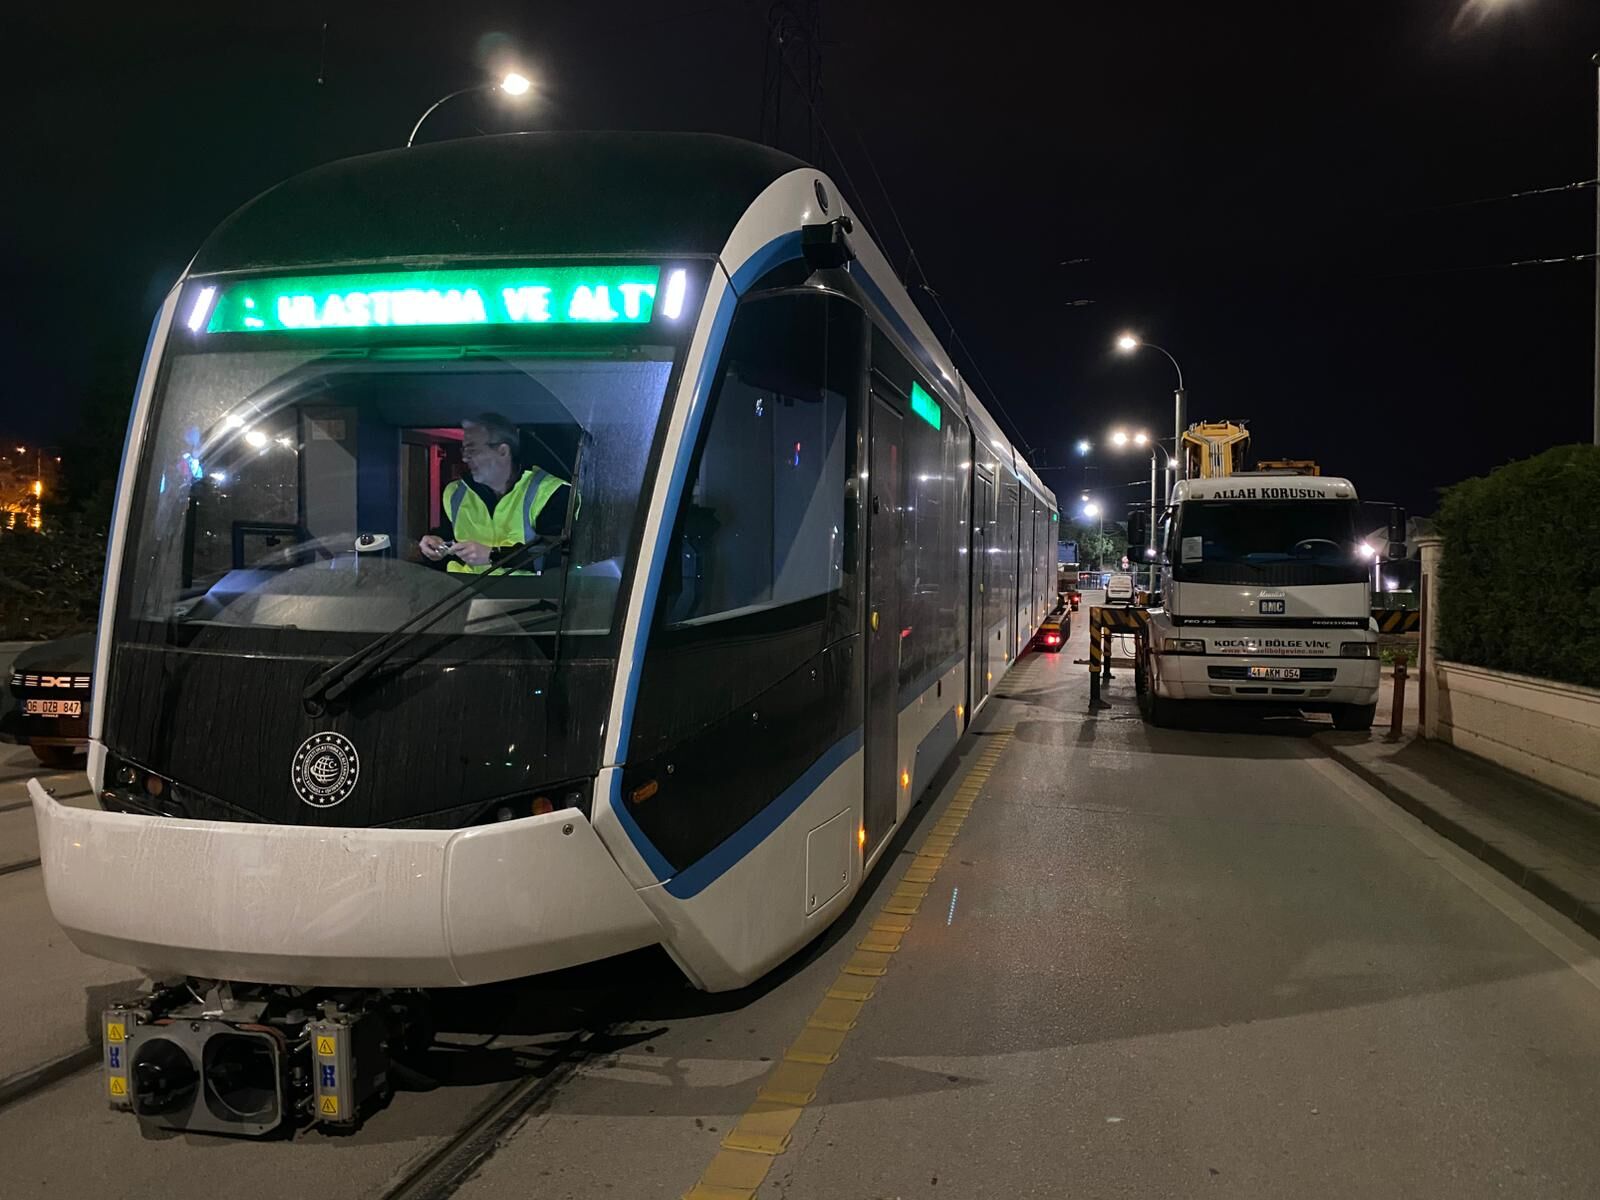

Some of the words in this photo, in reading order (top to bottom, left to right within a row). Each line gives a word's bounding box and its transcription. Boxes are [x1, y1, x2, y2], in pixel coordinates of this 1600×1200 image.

[502, 286, 552, 323] VE
[1214, 488, 1256, 499] ALLAH
[1261, 487, 1326, 498] KORUSUN
[1261, 601, 1283, 613] BMC
[1214, 639, 1262, 647] KOCAİ
[1265, 638, 1302, 647] BÖLGE
[1305, 640, 1331, 649] VİNÇ
[1251, 668, 1261, 677] 41
[1265, 668, 1281, 677] AKM
[1284, 669, 1299, 678] 054
[27, 701, 37, 712] 06
[63, 702, 79, 713] 847
